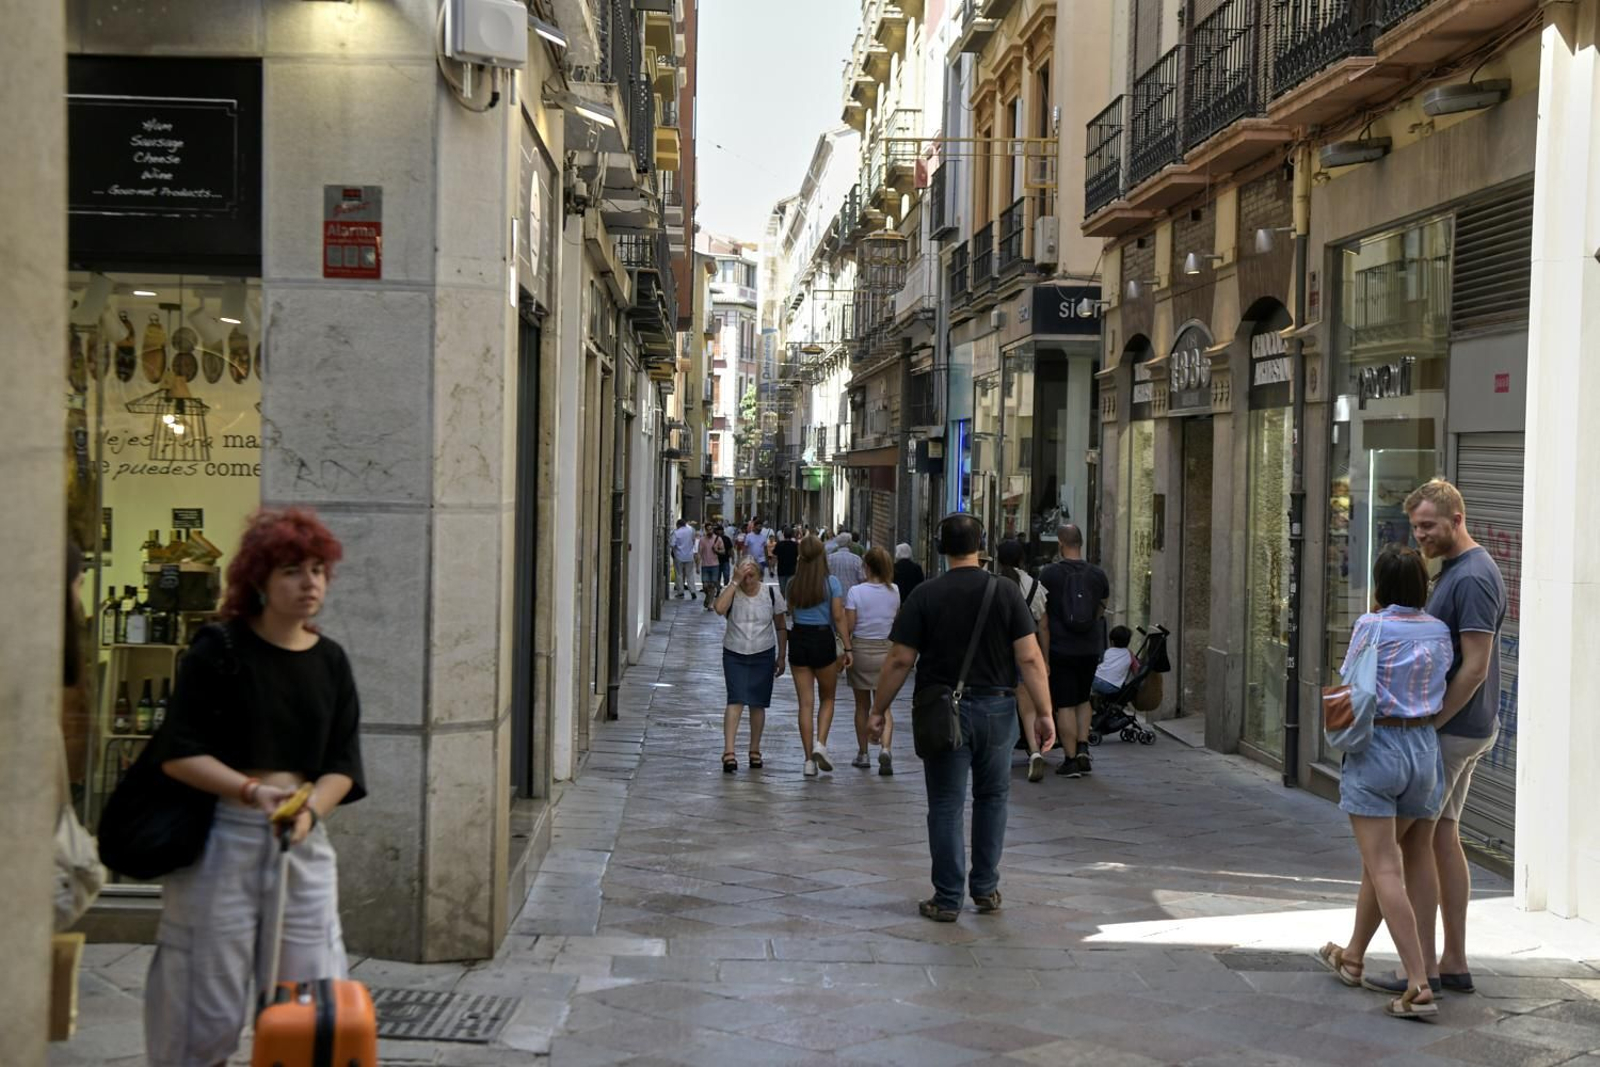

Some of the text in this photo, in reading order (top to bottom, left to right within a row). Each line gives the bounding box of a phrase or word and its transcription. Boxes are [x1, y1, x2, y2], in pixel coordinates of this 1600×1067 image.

[129, 134, 184, 153] Sausage
[133, 151, 181, 164] Cheese
[141, 167, 174, 180] Wine
[107, 184, 158, 196] Gourmet
[327, 224, 376, 237] Alarma
[112, 460, 197, 480] puedes
